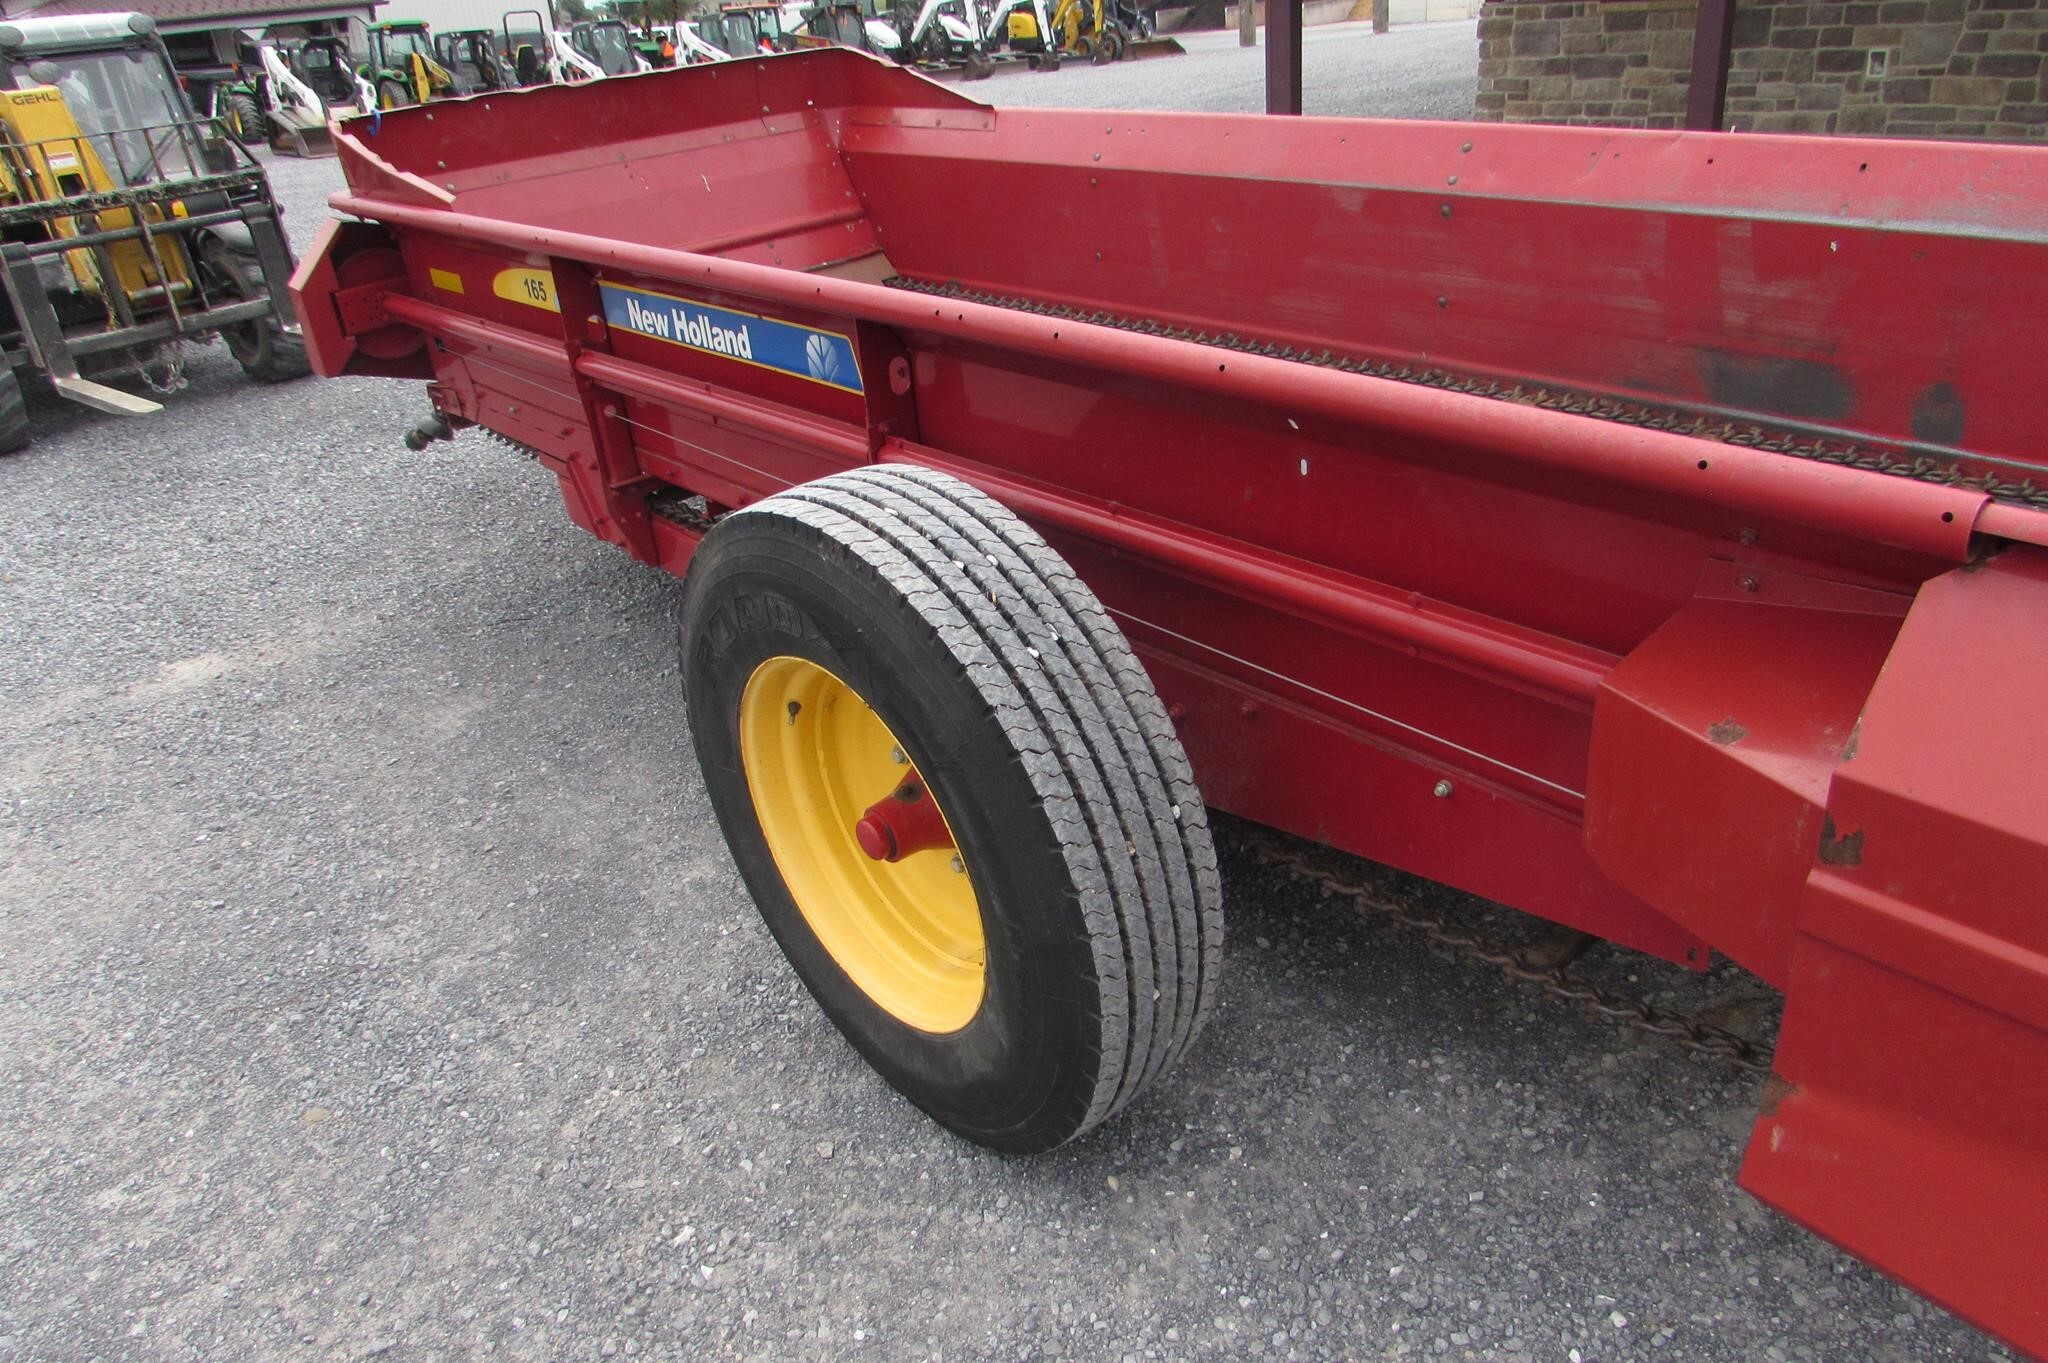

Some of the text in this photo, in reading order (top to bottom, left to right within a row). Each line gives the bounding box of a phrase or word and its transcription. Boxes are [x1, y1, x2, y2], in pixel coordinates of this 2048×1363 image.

[12, 92, 58, 105] GEHL
[523, 277, 547, 302] 165
[626, 297, 753, 359] New Holland
